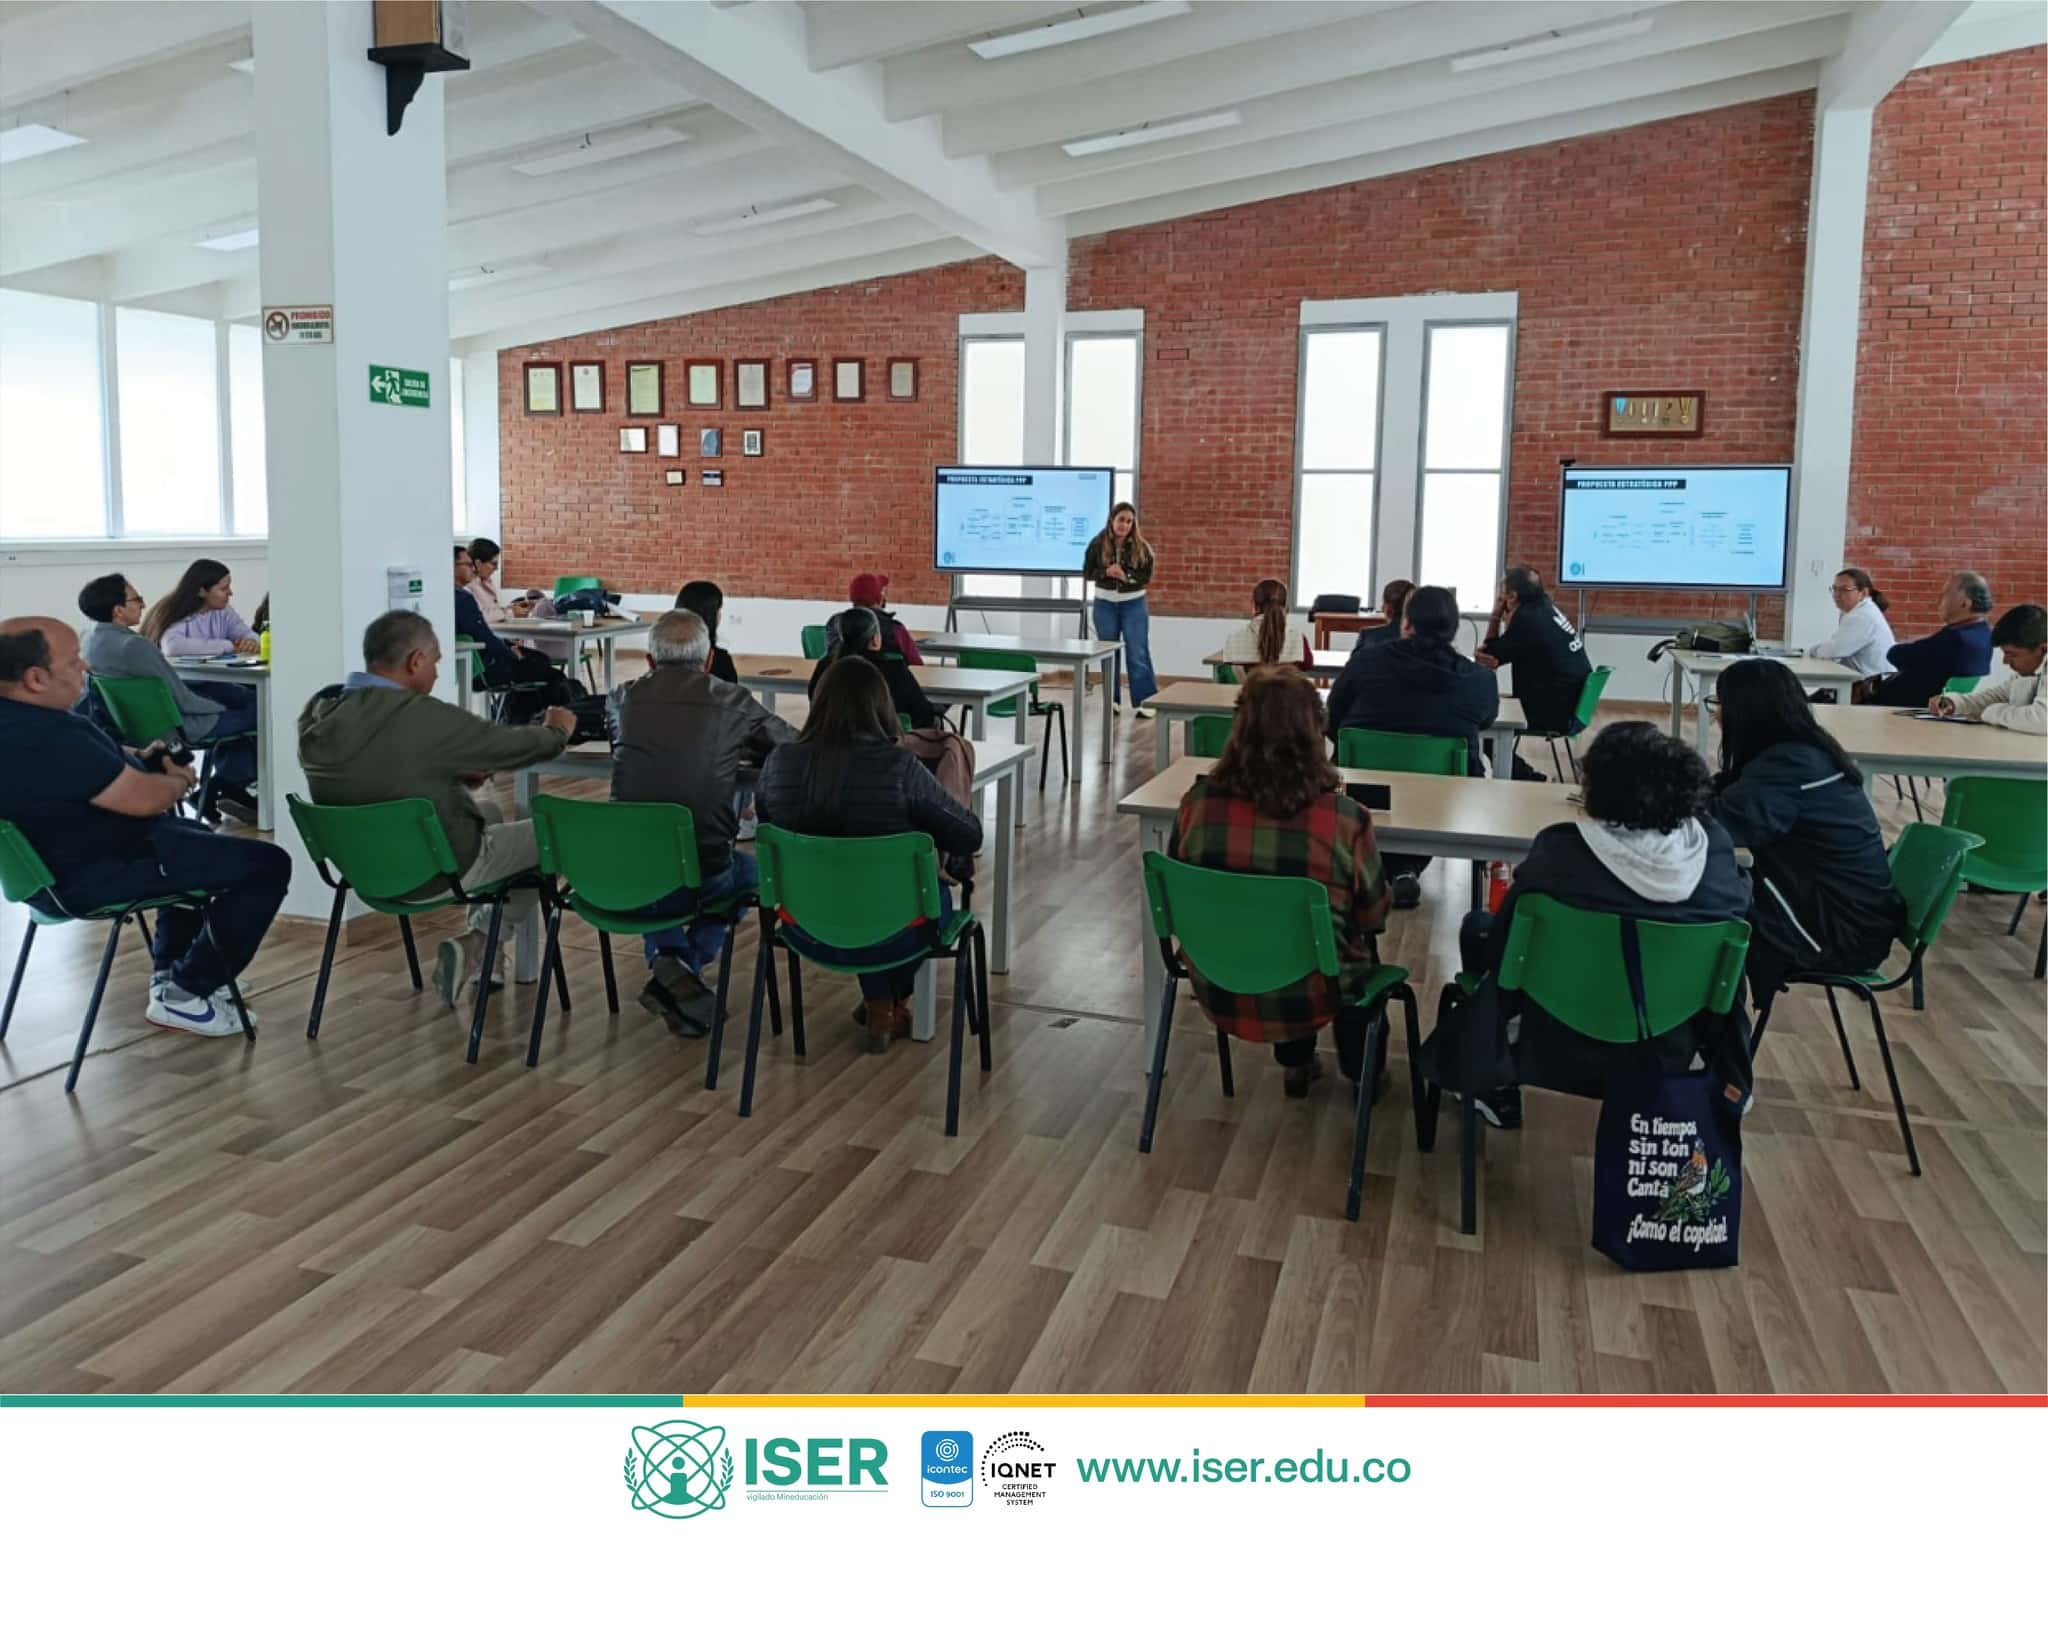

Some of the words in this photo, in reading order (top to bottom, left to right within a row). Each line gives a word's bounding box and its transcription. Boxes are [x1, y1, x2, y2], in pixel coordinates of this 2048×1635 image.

[1631, 1113, 1649, 1135] En
[1628, 1137, 1657, 1155] sin
[1662, 1139, 1689, 1157] ton
[1628, 1157, 1645, 1176] ni
[1648, 1161, 1678, 1177] son
[1669, 1219, 1681, 1242] el
